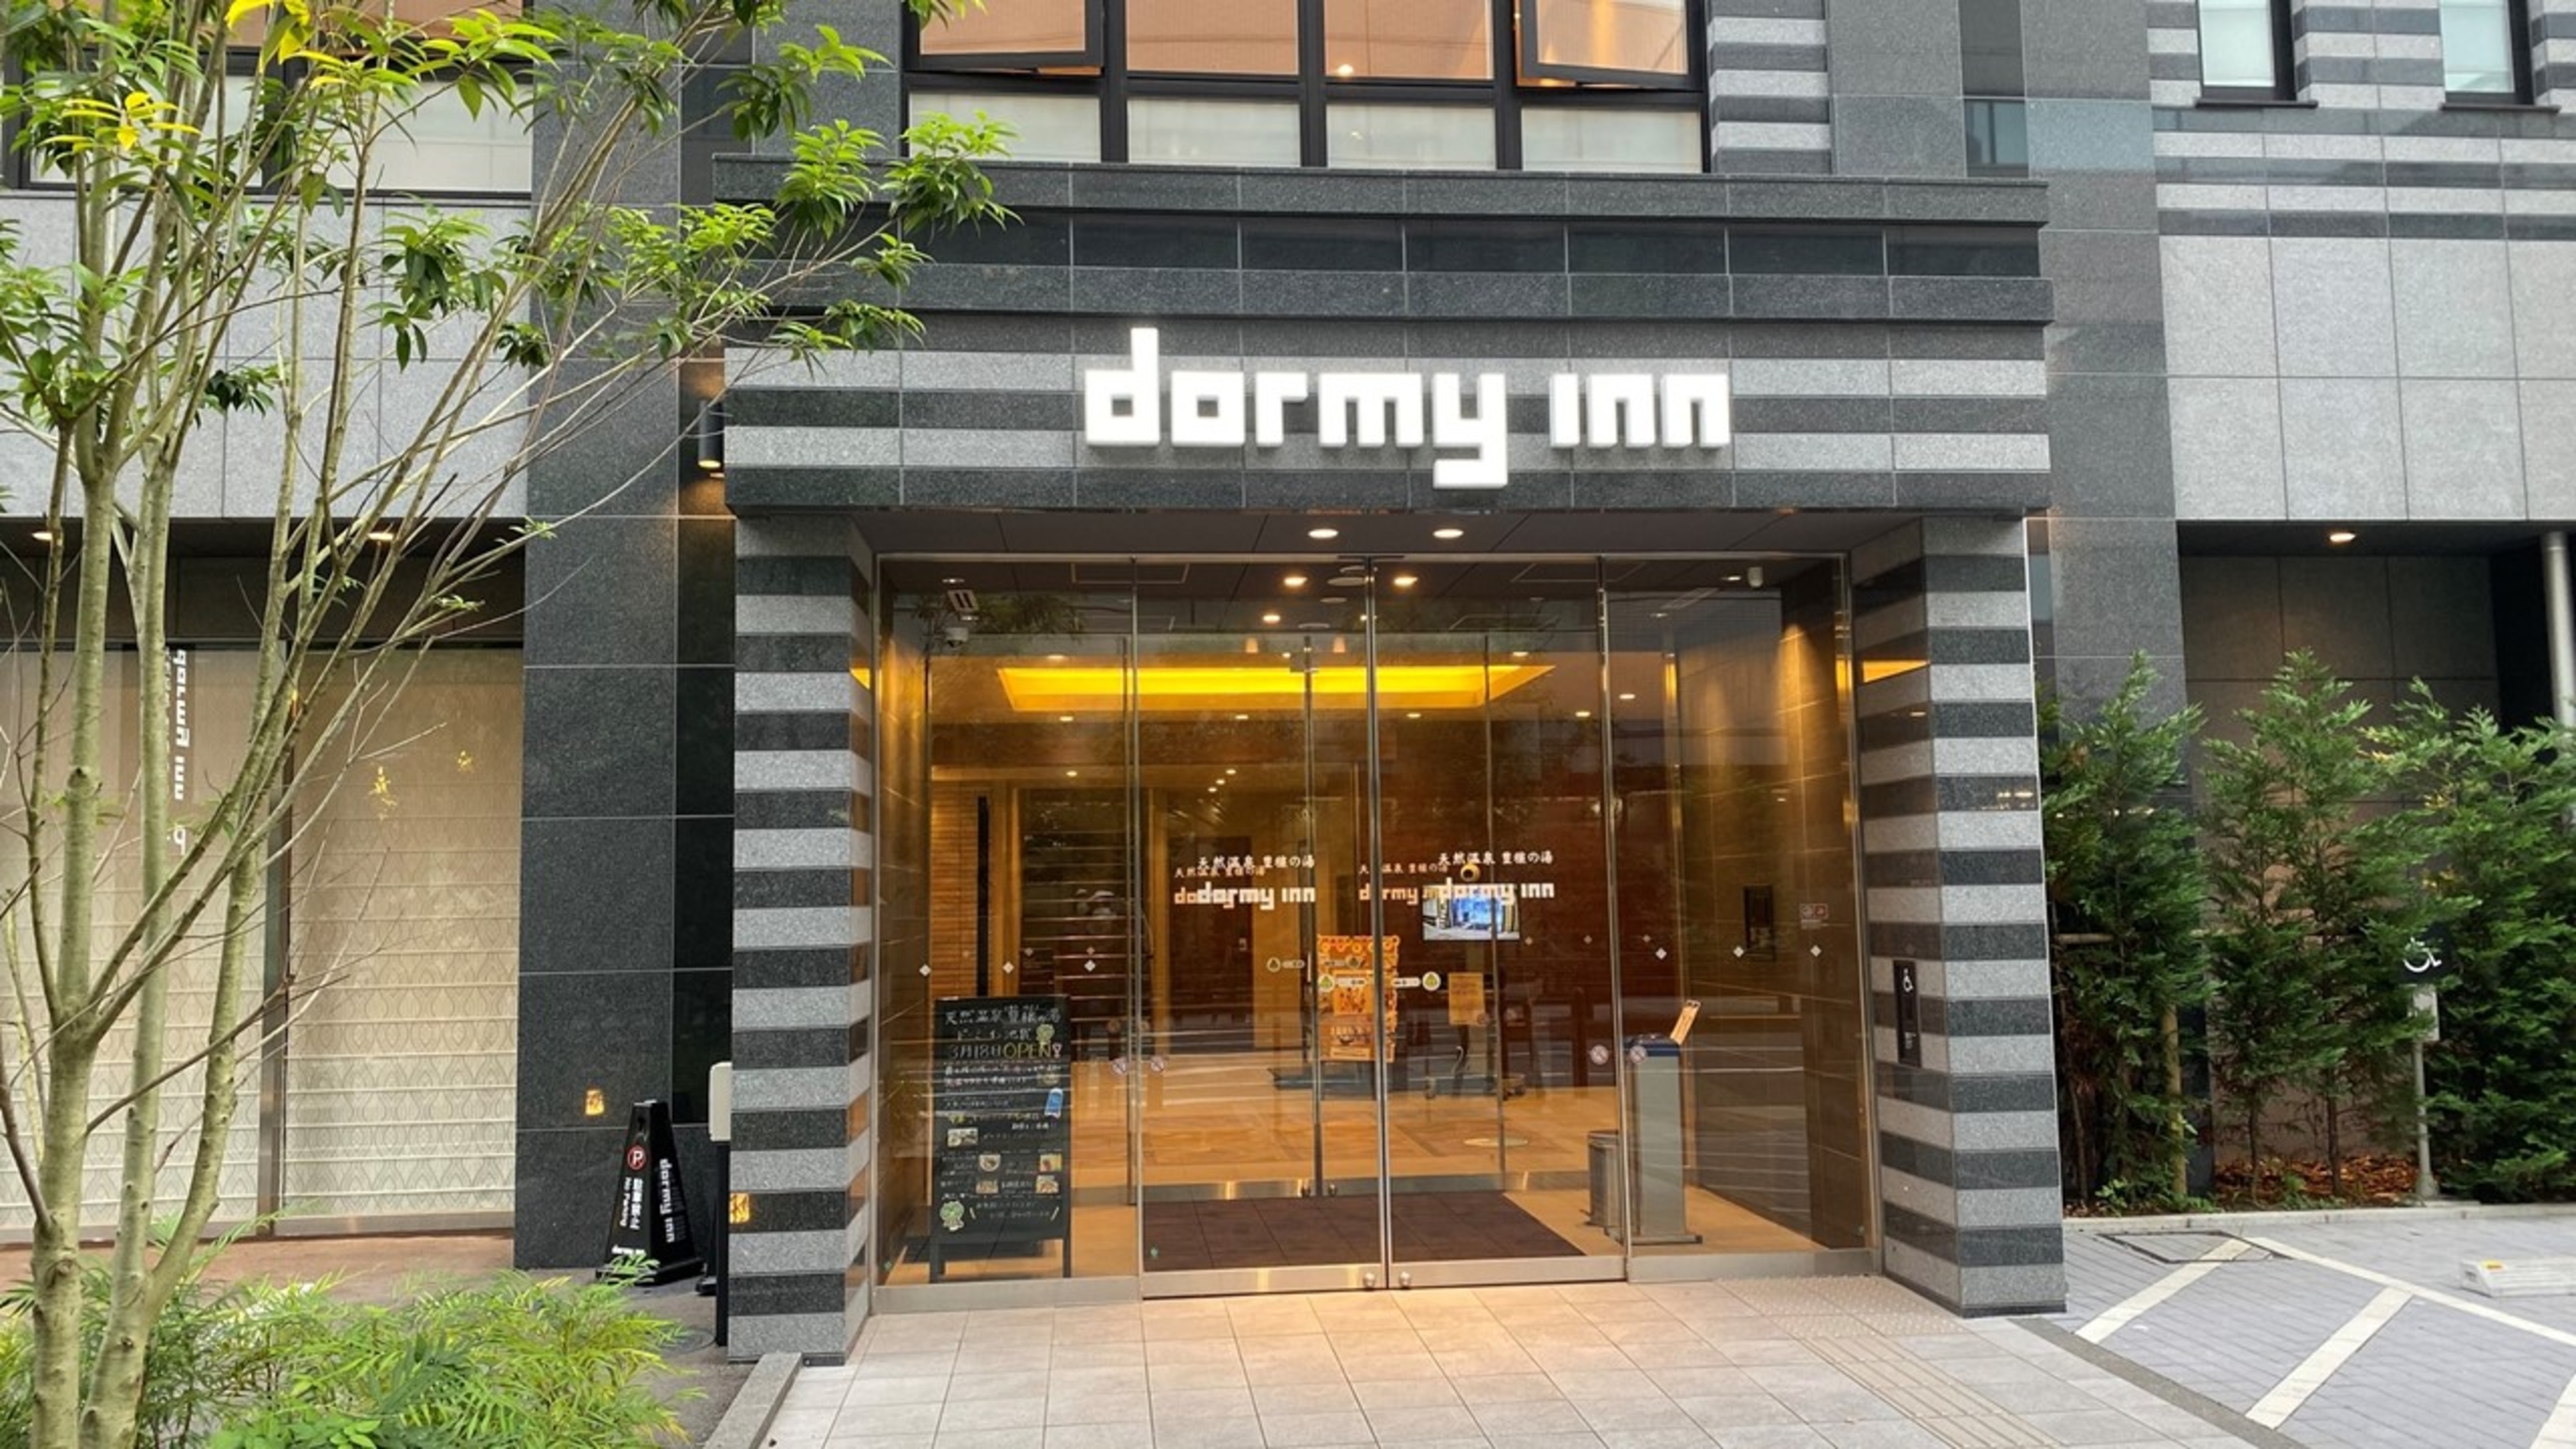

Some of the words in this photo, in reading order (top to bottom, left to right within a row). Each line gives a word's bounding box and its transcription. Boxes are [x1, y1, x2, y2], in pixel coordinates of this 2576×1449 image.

[1085, 328, 1507, 489] dormy
[1549, 373, 1730, 447] inn
[1438, 852, 1495, 866] 天然温泉
[1197, 881, 1275, 910] dormy
[1281, 886, 1315, 902] inn
[1359, 883, 1418, 905] drmy
[1438, 877, 1515, 906] dormy
[1521, 883, 1555, 899] inn
[660, 1159, 672, 1215] dormy
[665, 1218, 675, 1243] inn
